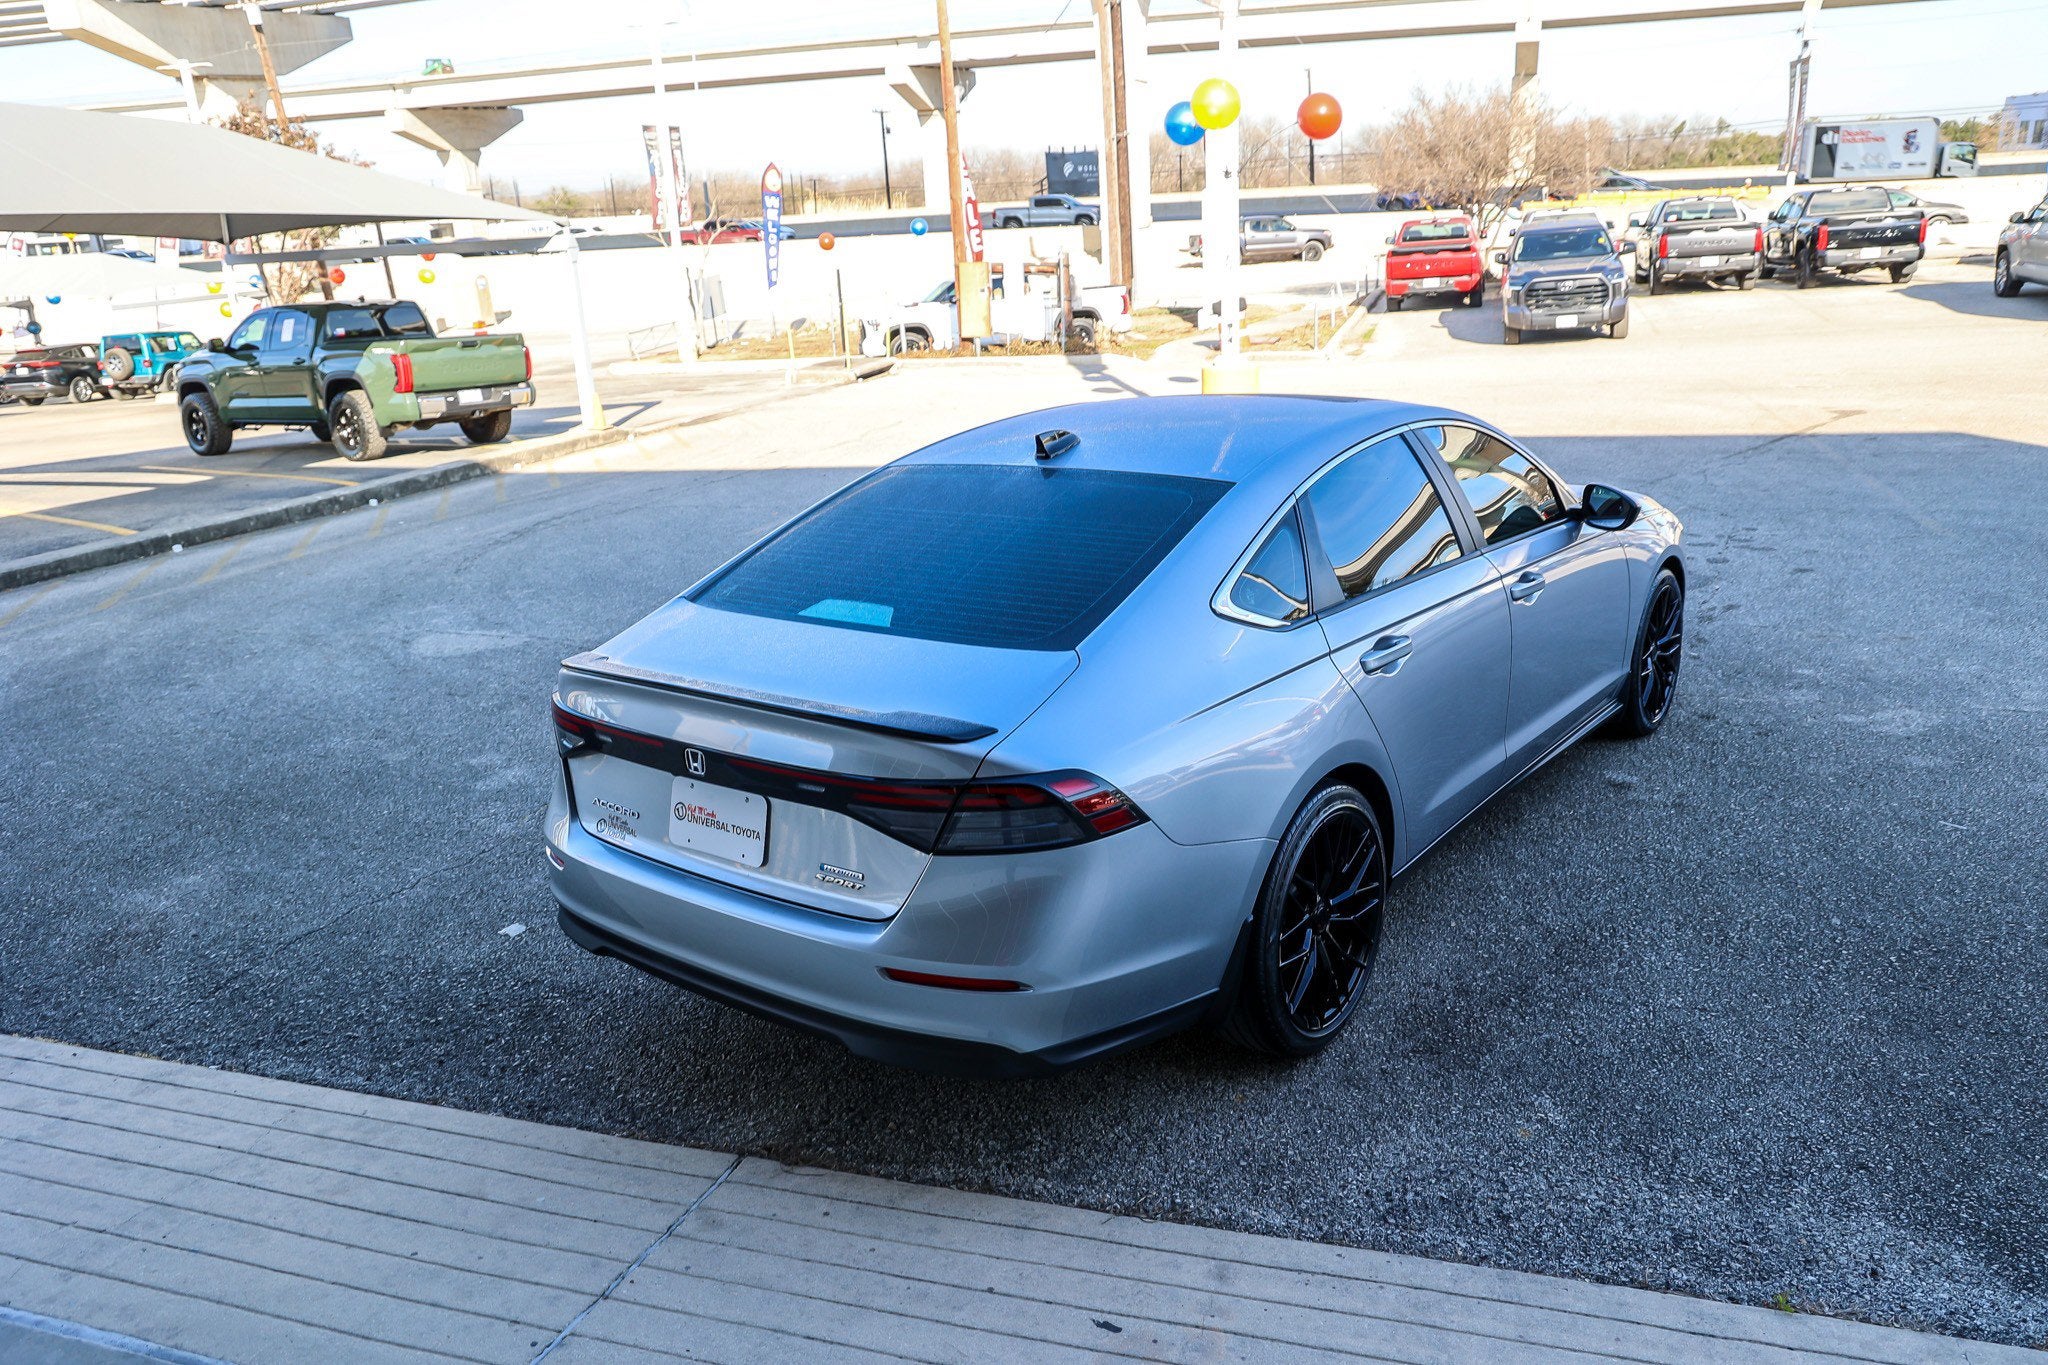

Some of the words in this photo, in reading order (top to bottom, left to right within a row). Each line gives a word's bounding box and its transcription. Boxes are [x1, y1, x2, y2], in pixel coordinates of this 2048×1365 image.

[1077, 164, 1098, 173] WORL
[591, 797, 640, 820] ACCORD
[608, 820, 638, 838] UNIVERSAL
[687, 813, 730, 833] UNIVERSAL
[731, 824, 761, 841] TOYOTA
[815, 873, 866, 890] SPORT
